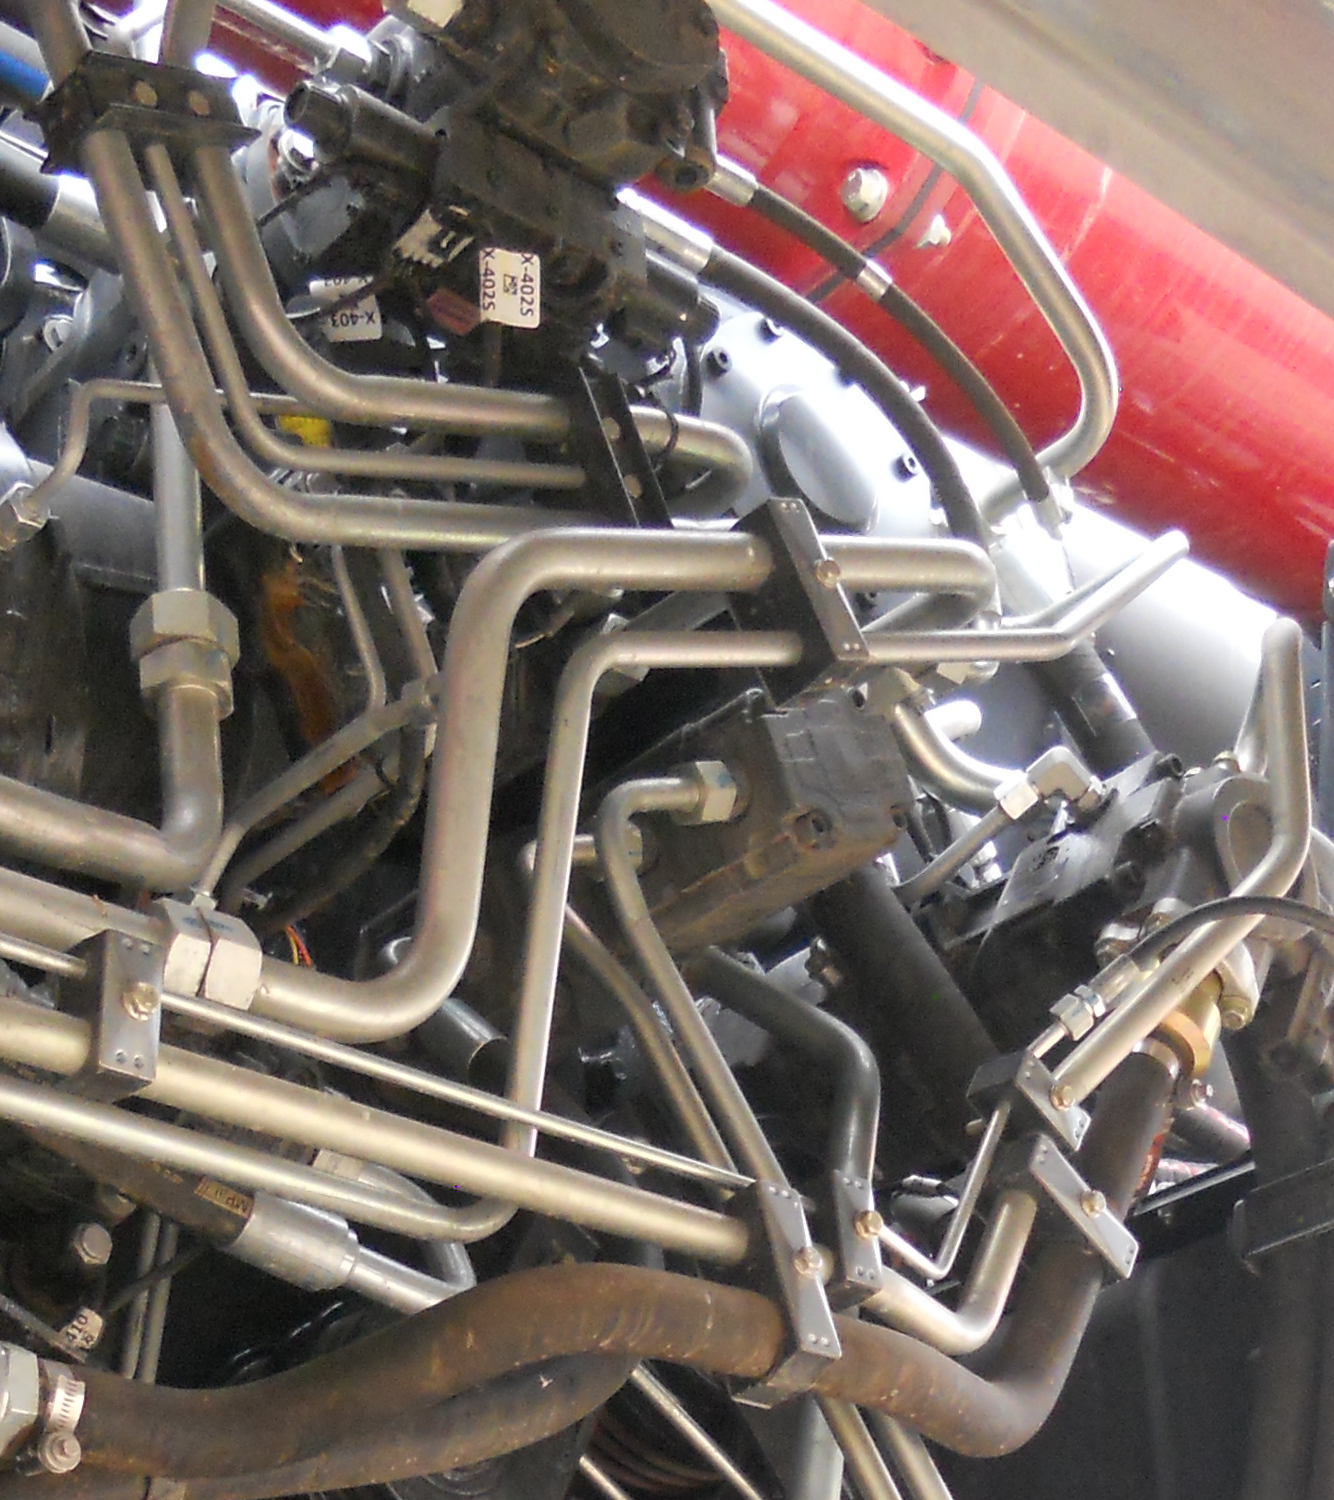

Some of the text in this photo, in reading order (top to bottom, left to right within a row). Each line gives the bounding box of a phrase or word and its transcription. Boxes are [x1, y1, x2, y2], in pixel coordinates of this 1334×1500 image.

[482, 248, 495, 310] X-402S
[520, 254, 533, 316] X-402S
[330, 311, 375, 327] X-403
